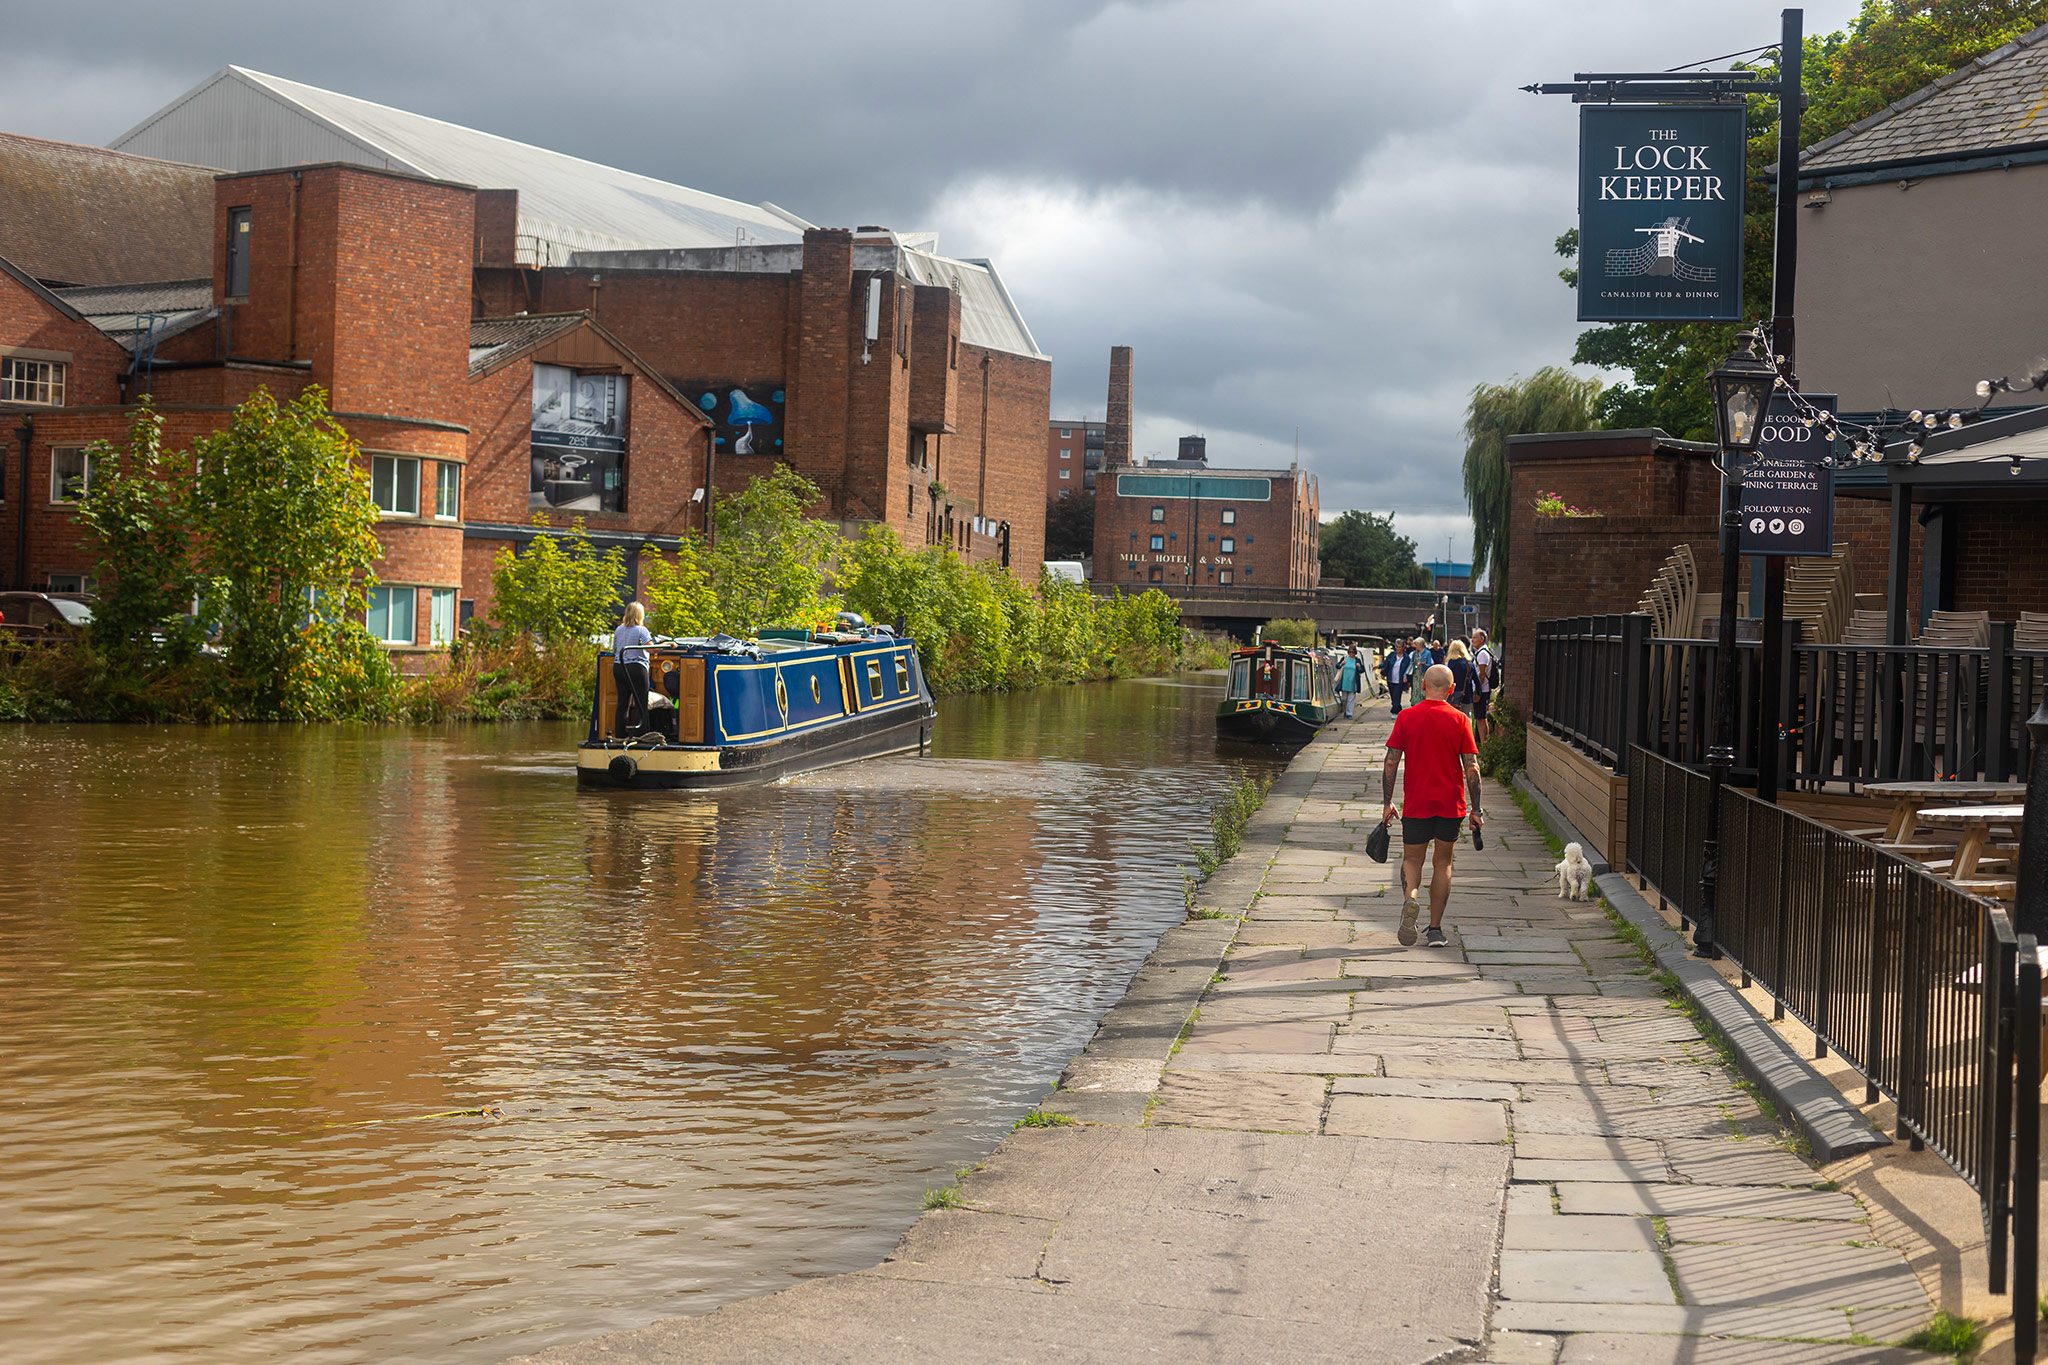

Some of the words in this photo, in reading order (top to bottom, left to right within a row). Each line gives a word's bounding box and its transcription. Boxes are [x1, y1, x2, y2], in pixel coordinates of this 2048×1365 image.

[1649, 130, 1678, 141] THE
[1614, 145, 1711, 170] LOCK
[1599, 176, 1725, 200] KEEPER
[568, 435, 589, 447] zest
[1767, 470, 1806, 479] GARDEN
[1808, 471, 1816, 479] &
[1744, 481, 1774, 490] INING
[1776, 481, 1819, 490] TERRACE
[1744, 505, 1781, 513] FOLLOW
[1783, 506, 1794, 514] US
[1795, 506, 1812, 514] ON:
[1120, 553, 1148, 562] MILL
[1199, 556, 1207, 564] &
[1215, 556, 1233, 565] SPA
